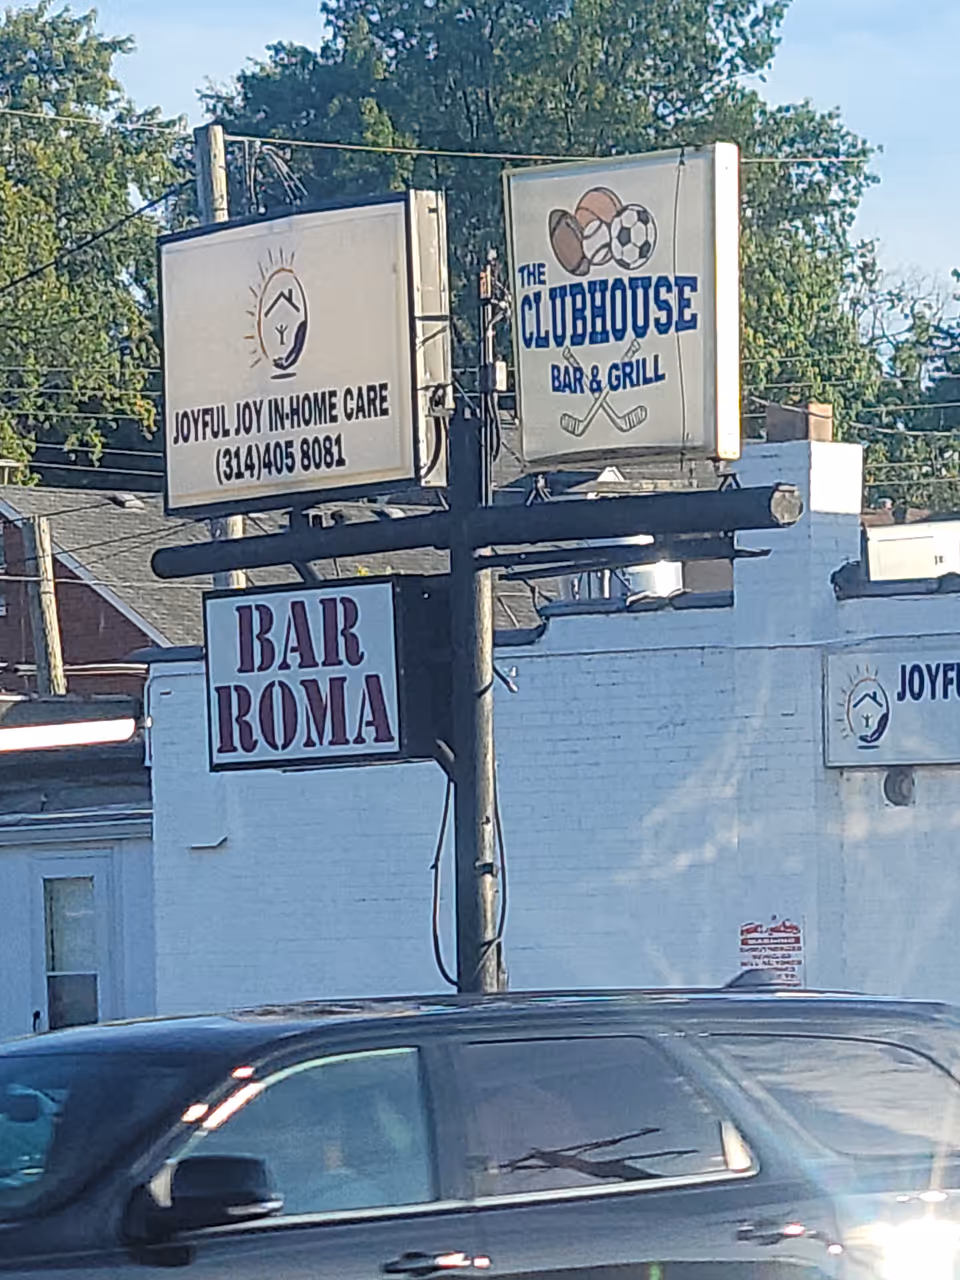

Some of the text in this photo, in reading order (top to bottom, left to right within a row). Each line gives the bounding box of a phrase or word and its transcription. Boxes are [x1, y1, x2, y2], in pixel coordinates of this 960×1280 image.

[518, 263, 546, 288] THE
[520, 275, 698, 349] CLUBHOUSE
[551, 354, 666, 395] BAR & GRILL
[173, 383, 390, 445] JOYFUL JOY IN-HOME CARE
[299, 433, 346, 472] 8081
[235, 597, 365, 674] BAR
[214, 674, 395, 753] ROMA
